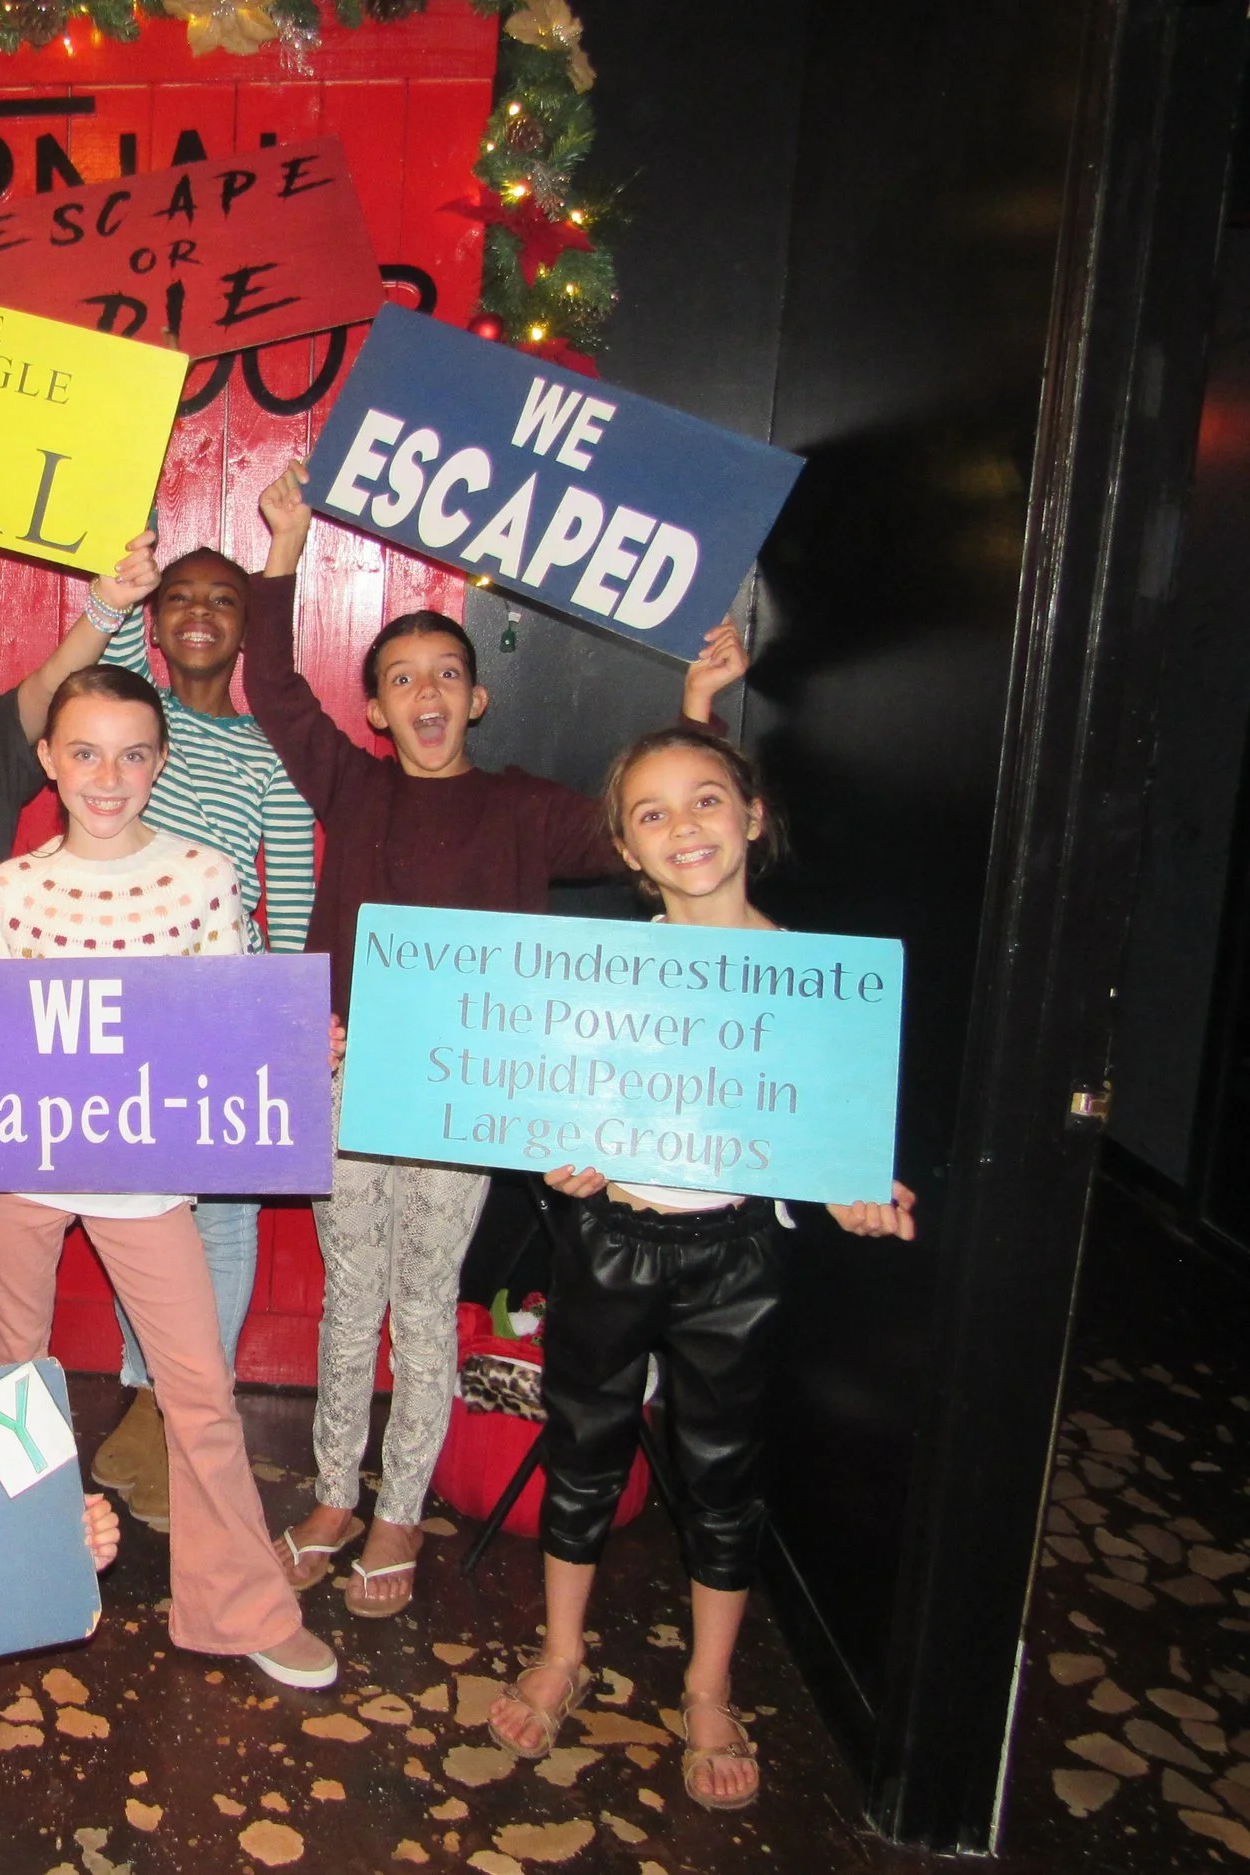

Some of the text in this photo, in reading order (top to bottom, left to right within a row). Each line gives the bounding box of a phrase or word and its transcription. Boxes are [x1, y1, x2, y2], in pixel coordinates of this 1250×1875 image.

[129, 239, 200, 275] OR
[78, 262, 302, 335] DIE
[511, 376, 617, 471] WE
[325, 409, 700, 629] ESCAPED
[366, 931, 885, 1003] Never Underestimate
[29, 979, 124, 1054] WE
[457, 991, 775, 1053] the Power of
[427, 1046, 798, 1115] Stupid People in
[442, 1103, 772, 1177] Large Groups
